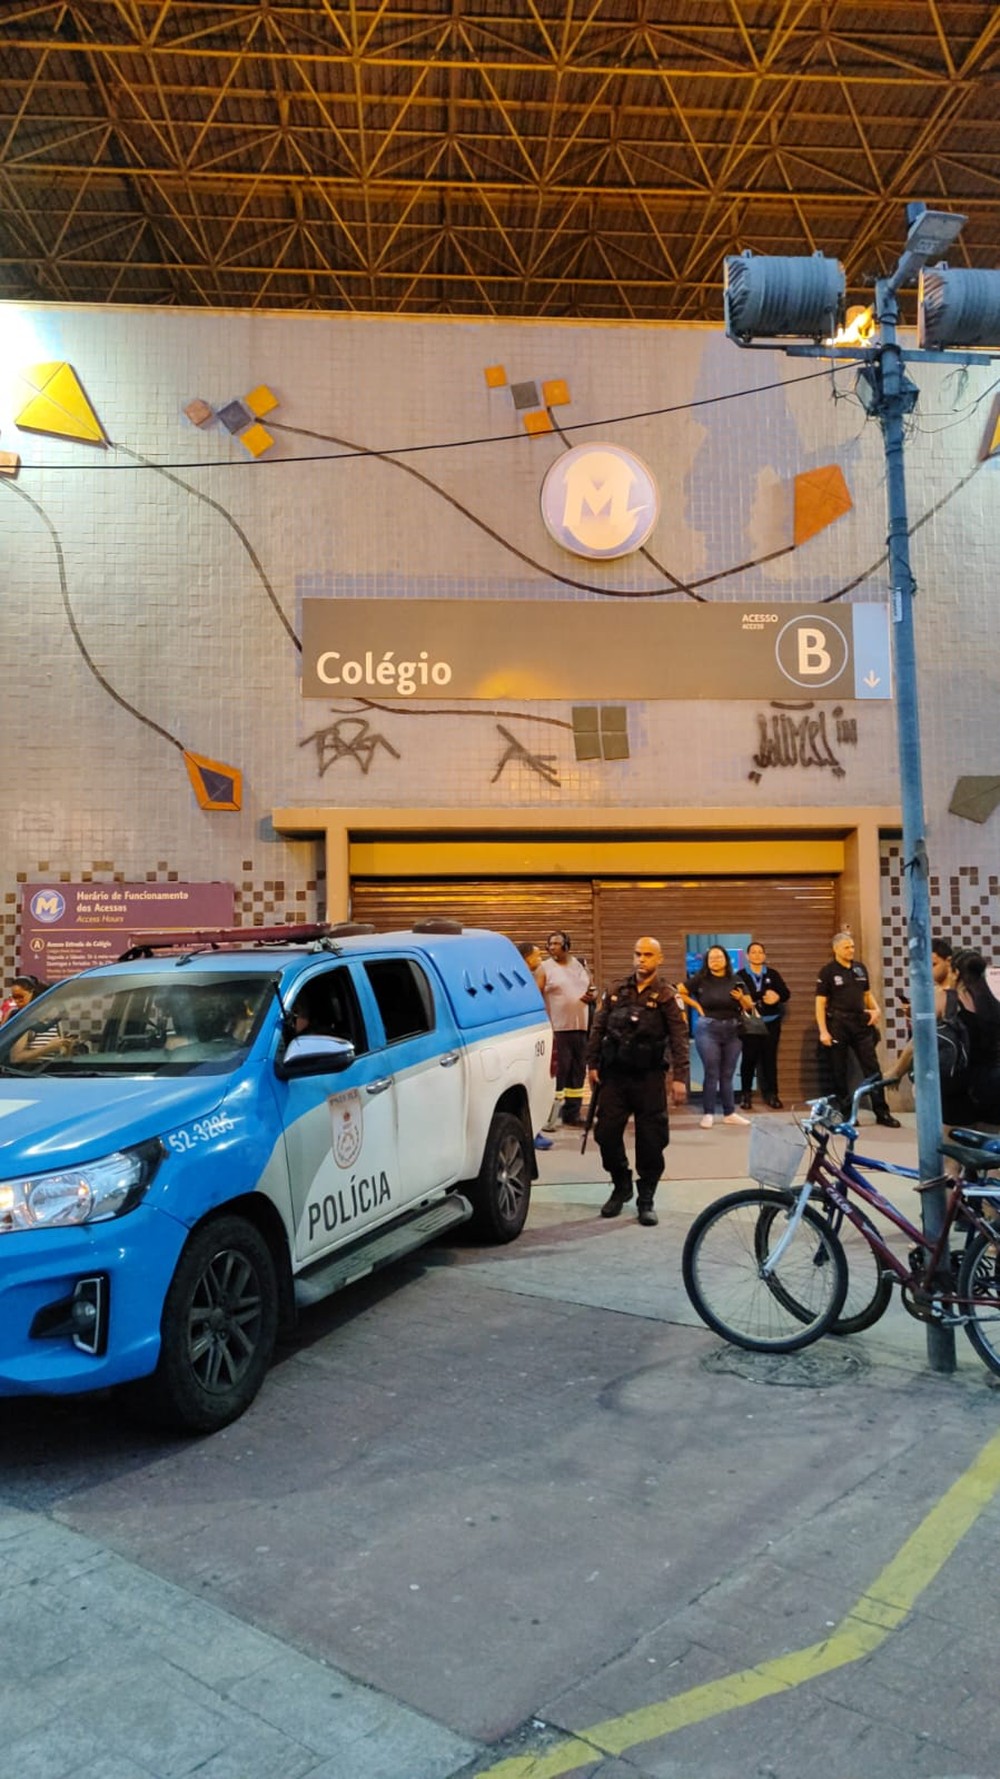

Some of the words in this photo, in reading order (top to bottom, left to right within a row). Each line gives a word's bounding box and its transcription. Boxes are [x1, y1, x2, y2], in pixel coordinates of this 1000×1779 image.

[742, 614, 778, 623] ACESSO
[797, 628, 831, 674] B
[316, 651, 452, 695] Colégio
[76, 891, 109, 900] Horário
[111, 891, 122, 900] de
[124, 890, 189, 900] Funcionamento
[76, 904, 92, 913] dos
[94, 904, 127, 913] Acessos
[308, 1170, 391, 1241] POLÍCIA
